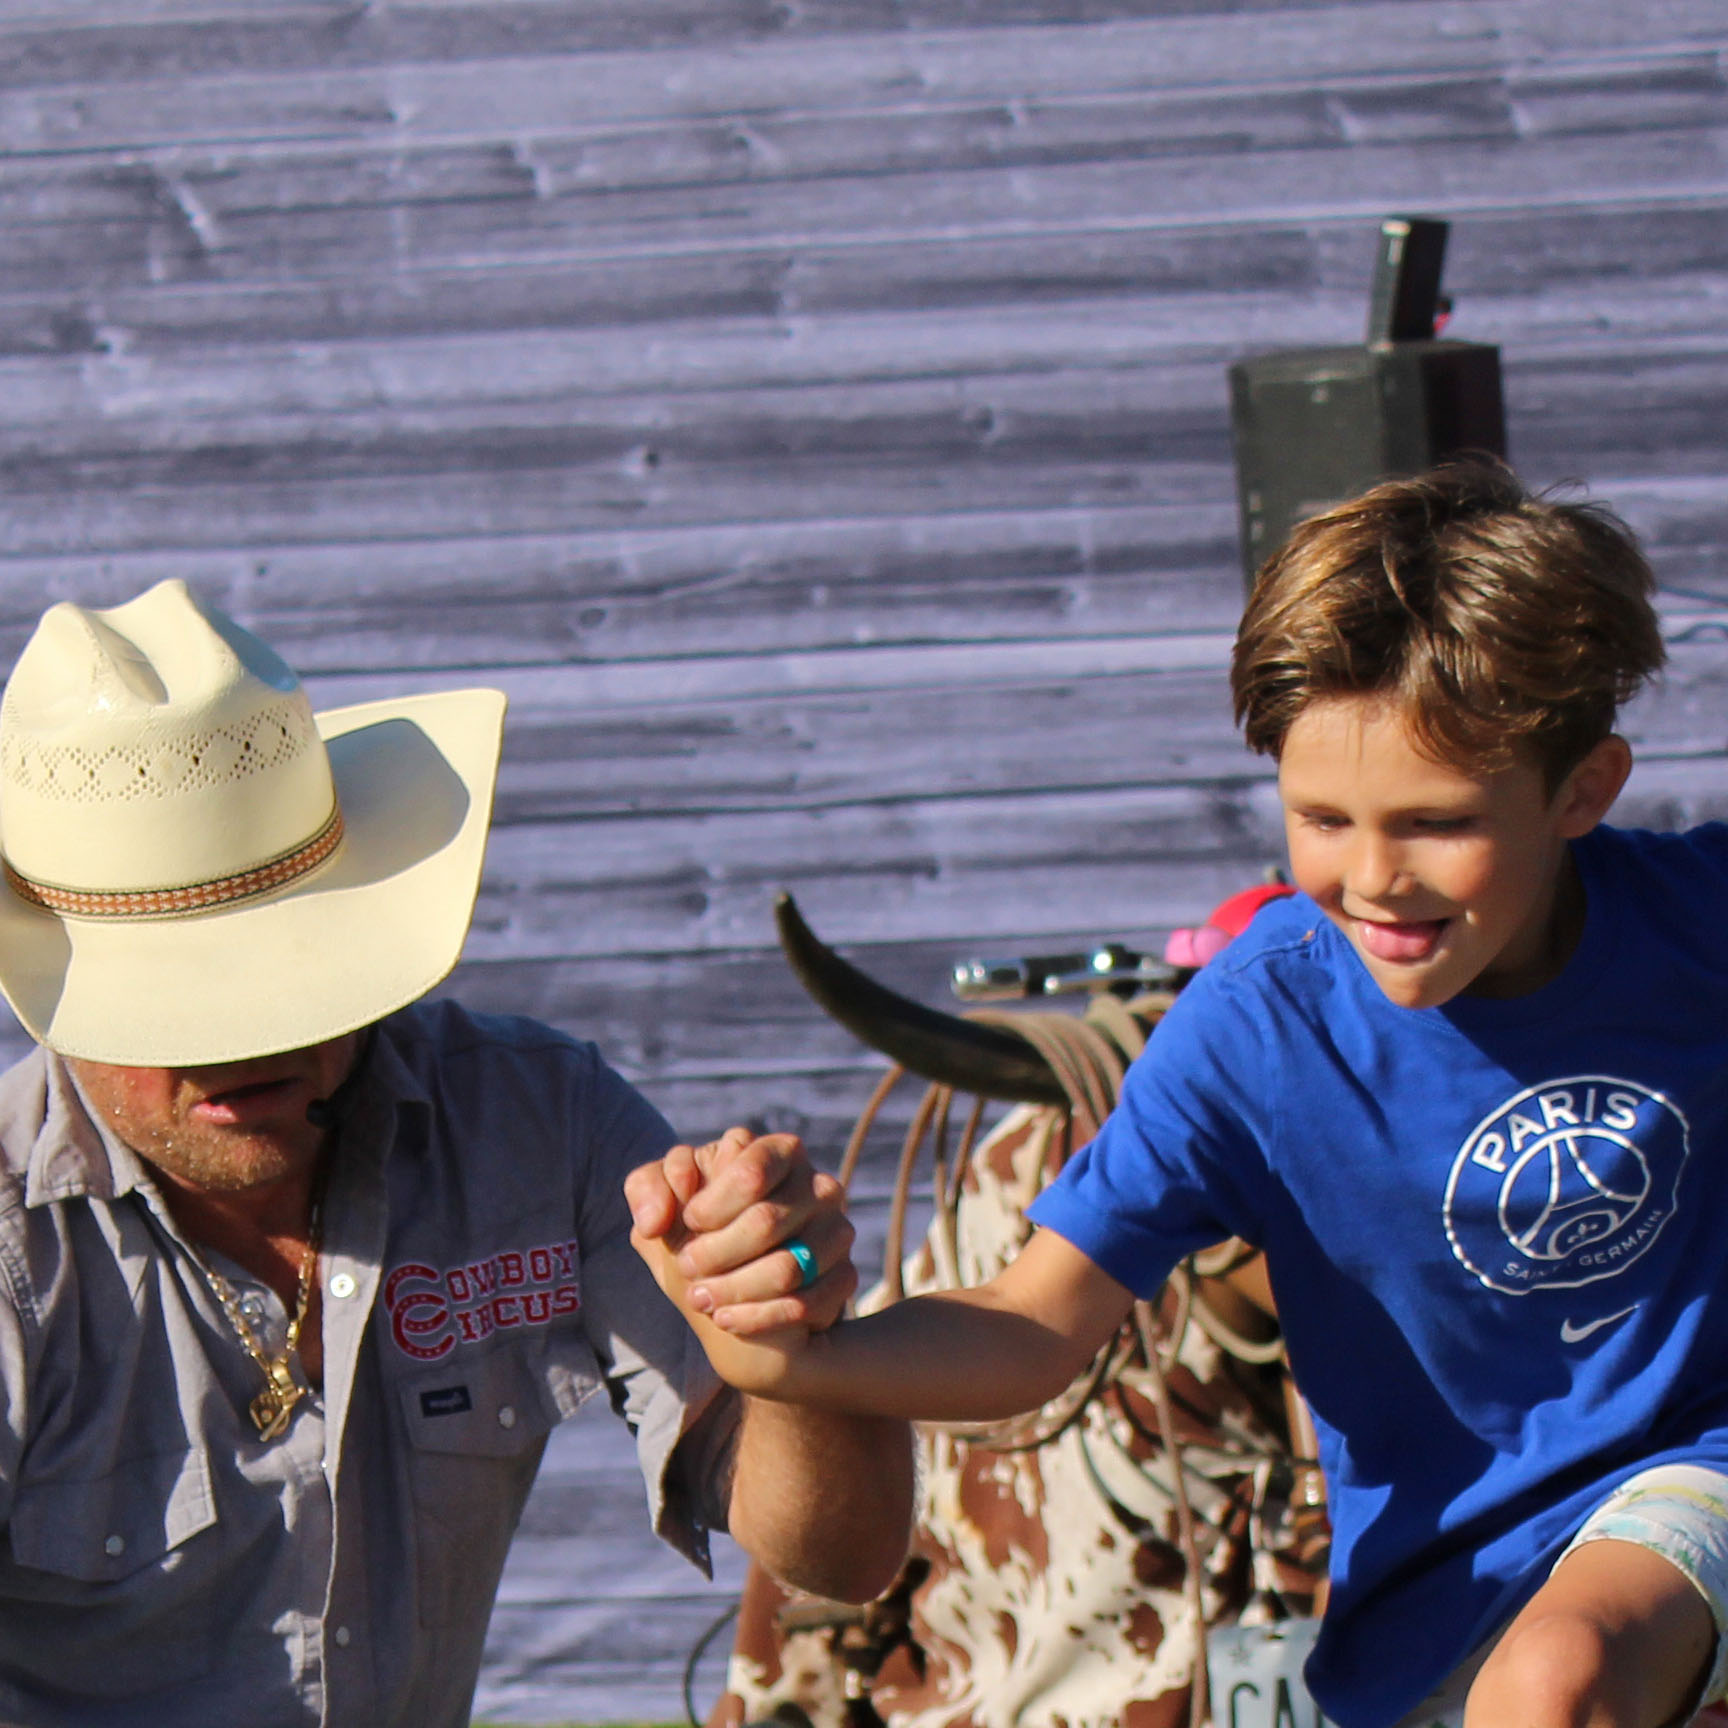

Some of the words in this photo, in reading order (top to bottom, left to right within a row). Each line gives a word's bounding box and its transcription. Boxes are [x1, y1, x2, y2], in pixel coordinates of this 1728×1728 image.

[1472, 1088, 1639, 1172] PARIS
[385, 1242, 577, 1334] COWBOY
[391, 1284, 579, 1361] CIRCUS
